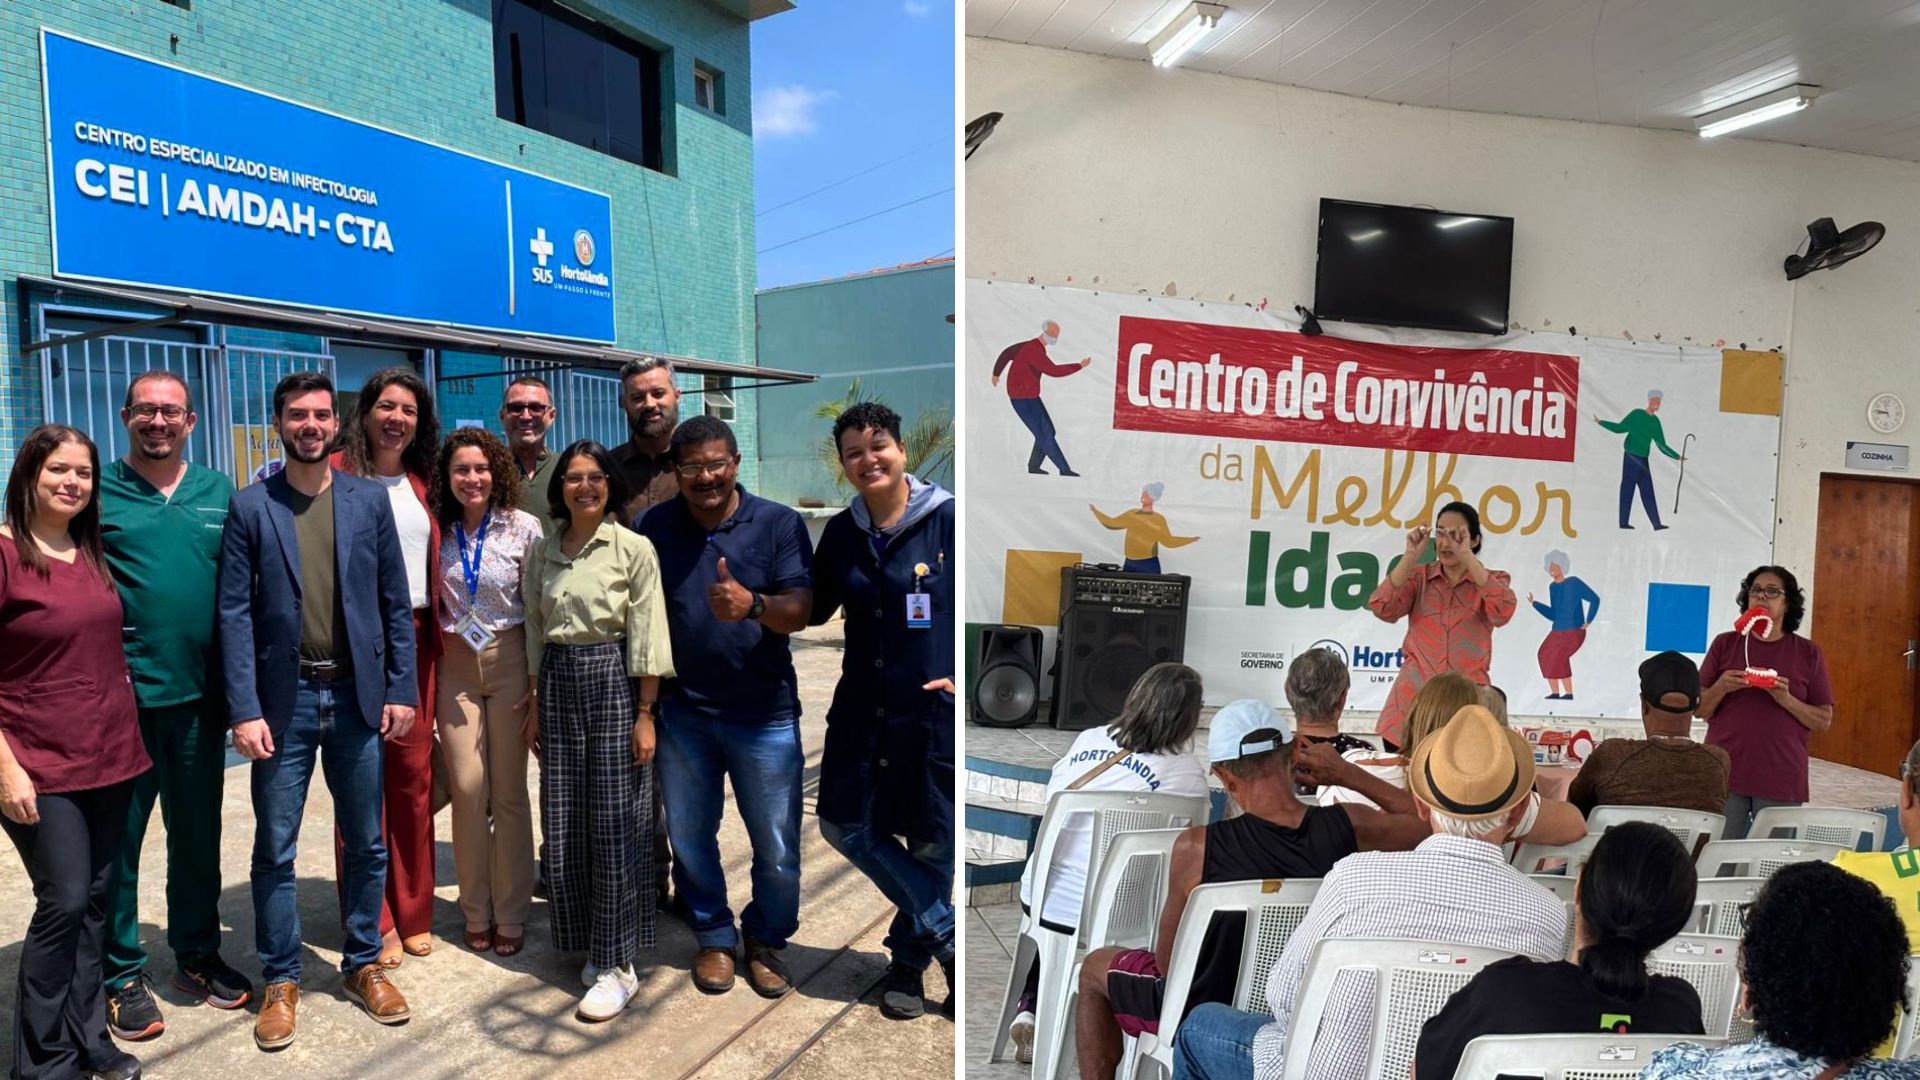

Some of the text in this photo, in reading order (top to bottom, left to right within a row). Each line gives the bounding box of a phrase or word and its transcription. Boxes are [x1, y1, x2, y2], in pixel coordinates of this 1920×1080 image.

[75, 121, 378, 206] CENTRO ESPECIALIZADO EM INFECTOLOGIA
[75, 159, 149, 206] CEI
[532, 267, 554, 284] SUS
[1127, 342, 1567, 439] Centro de Convivência
[1861, 452, 1893, 461] COZINHA
[1200, 443, 1578, 539] da Melhor
[1240, 651, 1275, 659] SECRETARIA
[1240, 659, 1284, 670] GOVERNO
[1353, 645, 1404, 668] Hort
[1370, 675, 1385, 683] UM
[1070, 750, 1161, 792] HORTOÂNDIA
